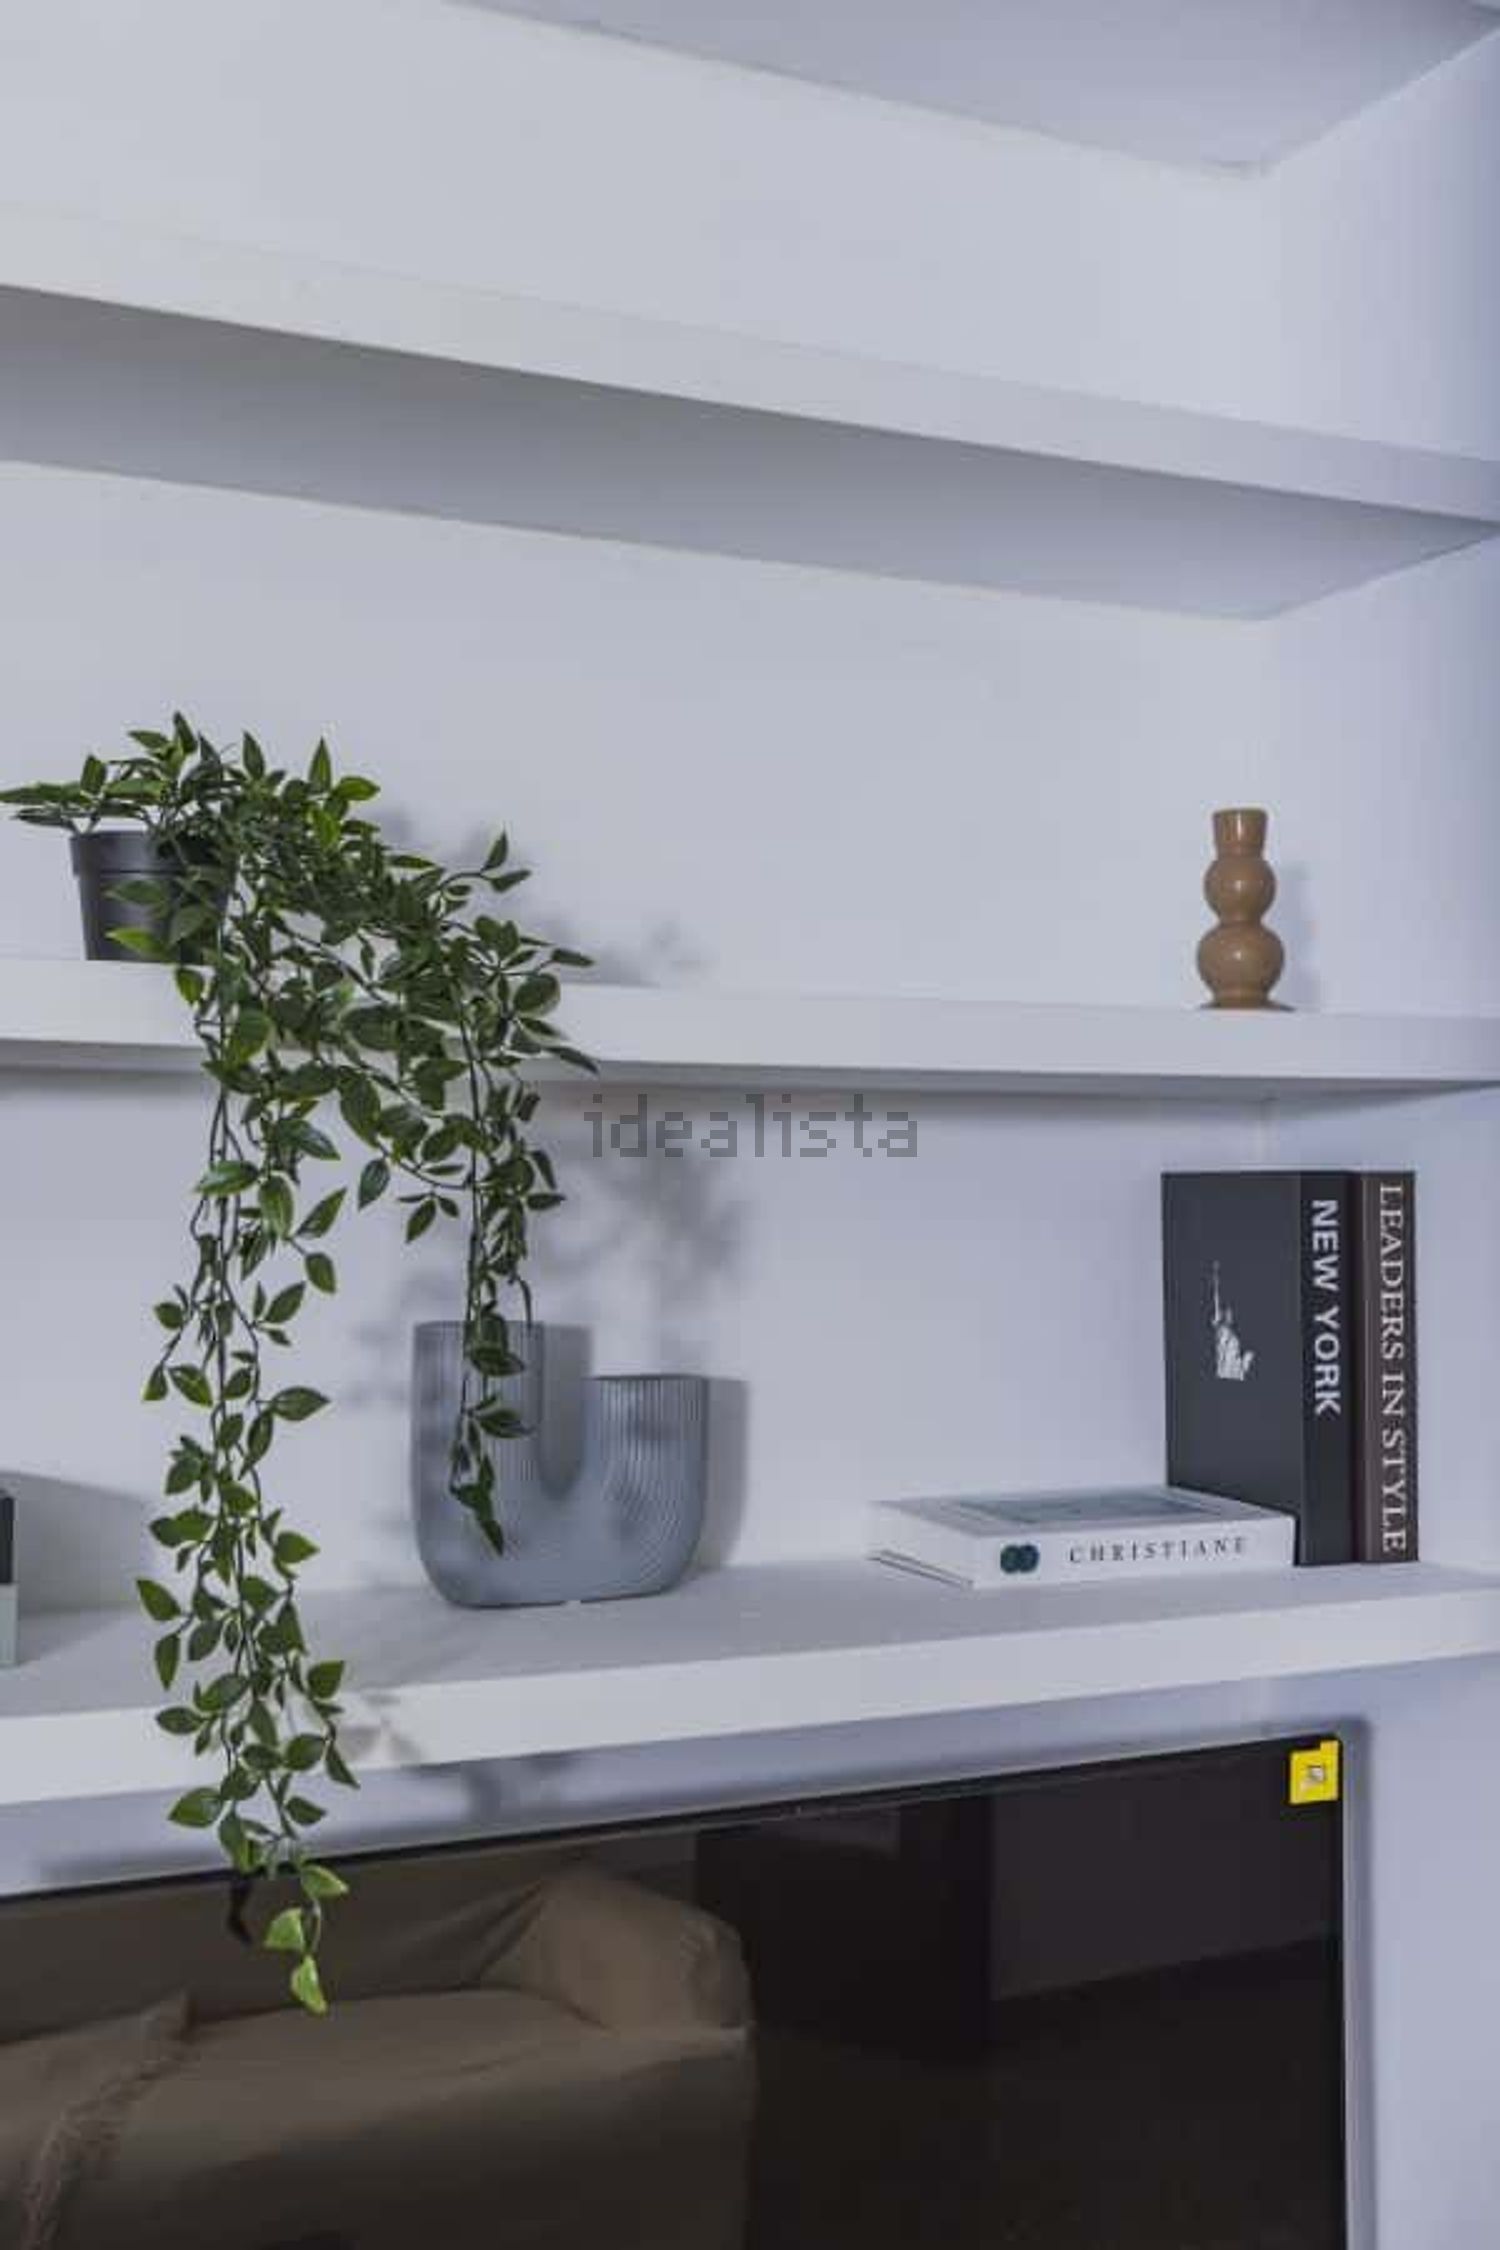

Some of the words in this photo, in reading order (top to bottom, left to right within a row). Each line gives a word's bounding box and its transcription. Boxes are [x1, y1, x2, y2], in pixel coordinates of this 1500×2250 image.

[1312, 1200, 1341, 1291] NEW
[1379, 1184, 1405, 1361] LEADERS
[1313, 1306, 1342, 1416] YORK
[1381, 1372, 1406, 1417] IN
[1381, 1427, 1407, 1553] STYLE
[1069, 1537, 1246, 1564] CHRISTIANE
